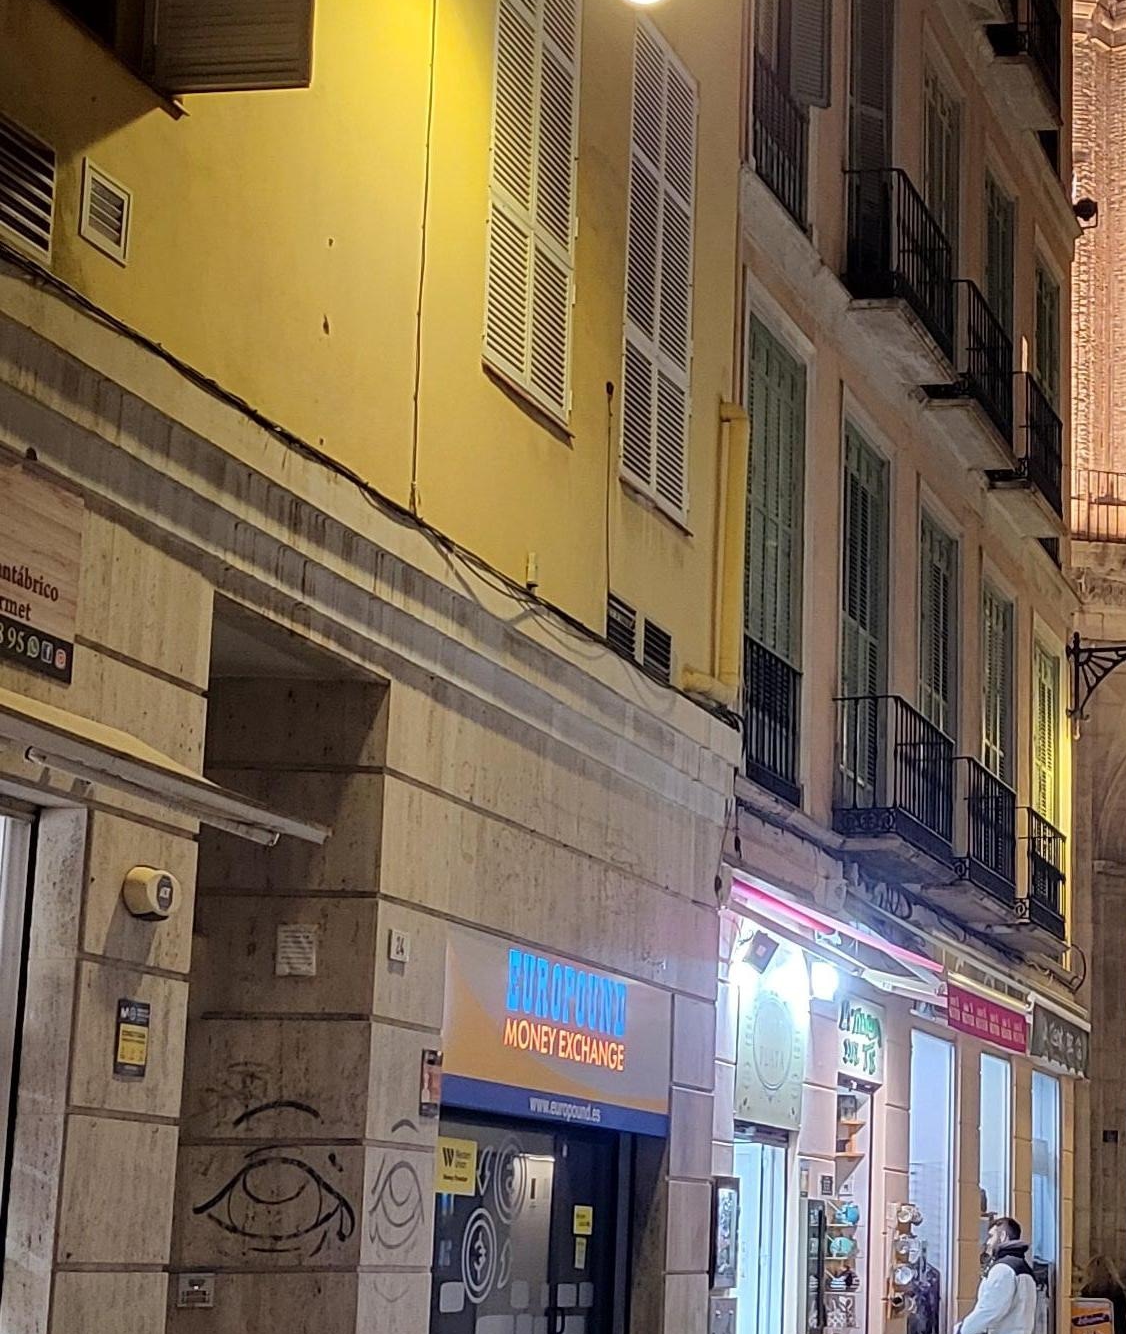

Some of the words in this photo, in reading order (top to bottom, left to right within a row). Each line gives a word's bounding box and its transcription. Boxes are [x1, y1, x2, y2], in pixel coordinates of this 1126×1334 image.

[0, 563, 59, 602] ntábrico
[506, 948, 627, 1037] EUROPOUND
[503, 1017, 558, 1056] MONEY
[558, 1029, 626, 1072] EXCHANGE
[529, 1097, 602, 1123] www.europound.es
